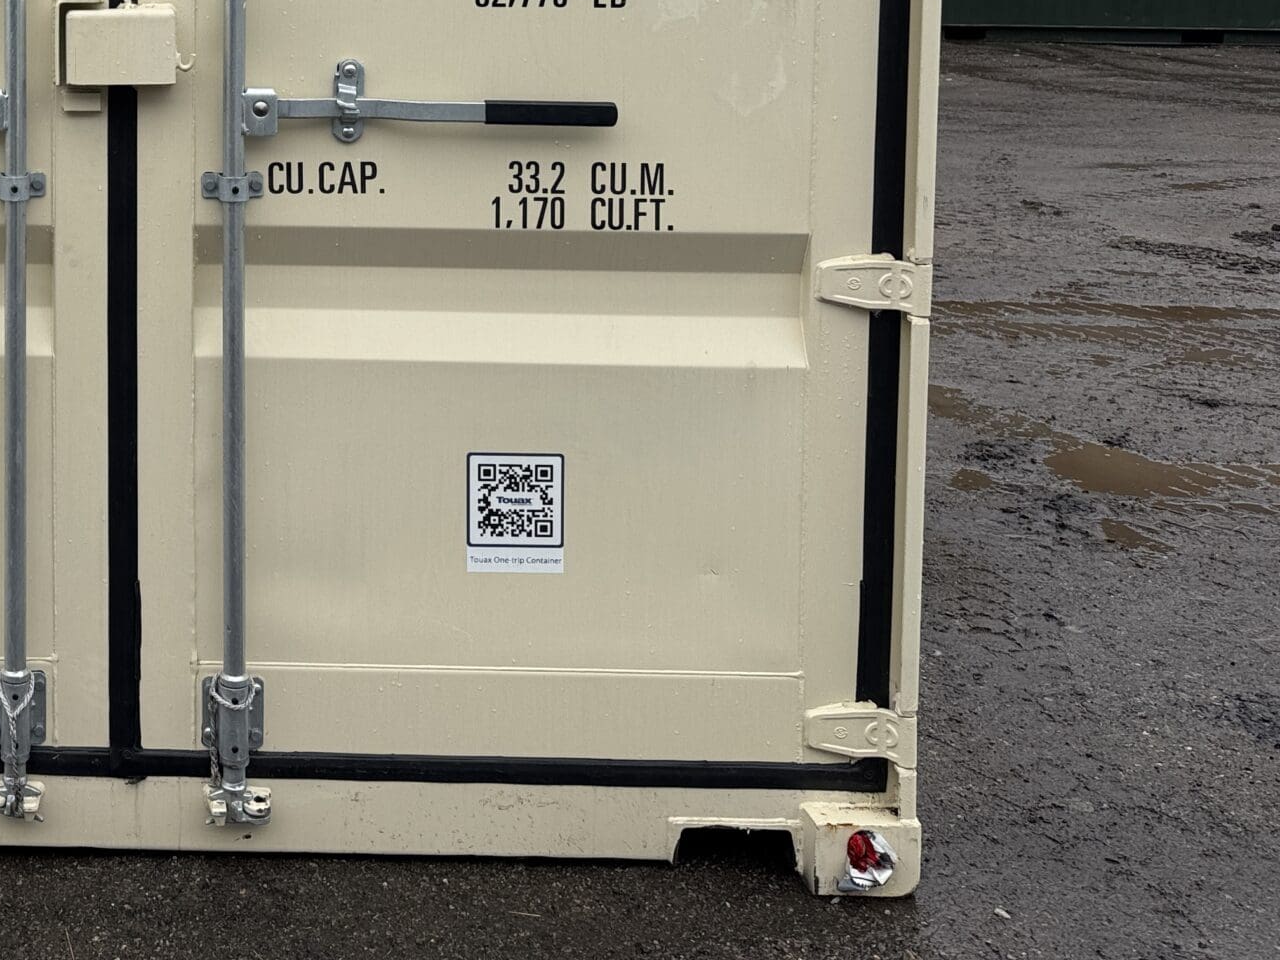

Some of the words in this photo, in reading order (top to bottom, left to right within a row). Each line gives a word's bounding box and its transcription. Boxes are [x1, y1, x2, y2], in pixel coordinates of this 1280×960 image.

[267, 161, 385, 195] CU.CAP.
[507, 160, 565, 194] 33.2
[590, 161, 674, 196] CU.M.
[590, 197, 674, 231] CU.FT.
[470, 556, 492, 564] Touax
[494, 556, 525, 565] One-trip
[526, 556, 562, 565] Container
